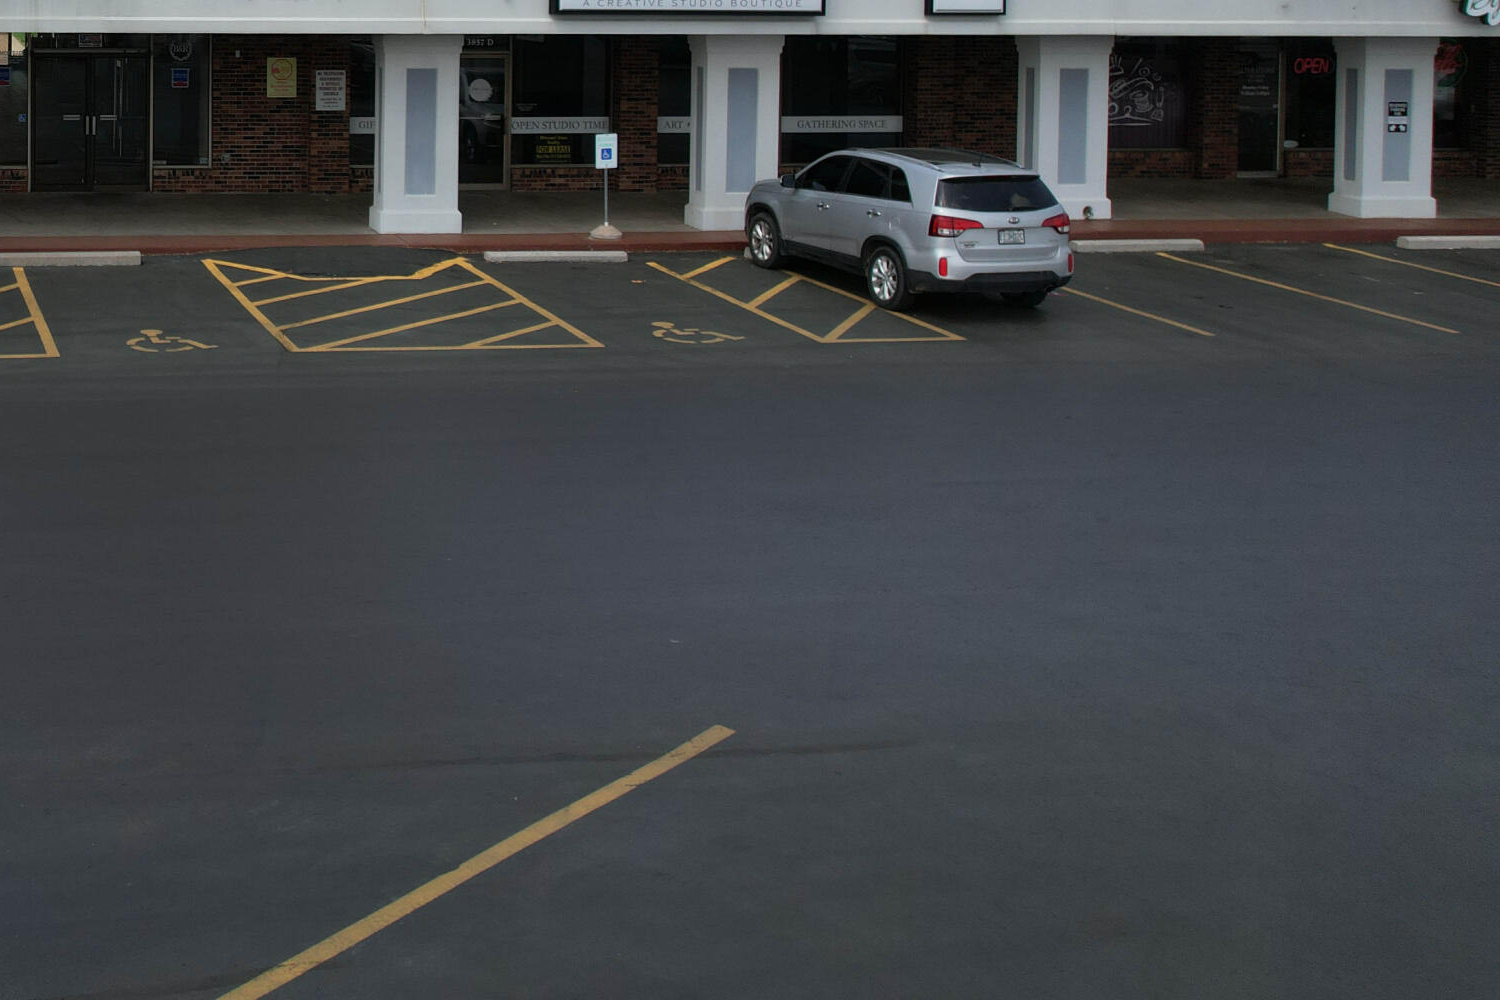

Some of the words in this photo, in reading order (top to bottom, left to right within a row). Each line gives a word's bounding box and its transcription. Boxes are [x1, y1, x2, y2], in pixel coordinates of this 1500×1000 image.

[582, 0, 590, 8] A
[597, 0, 664, 8] CREATIVE
[671, 0, 723, 8] STUDIO
[731, 0, 802, 9] BOUTIQUE
[487, 38, 494, 46] D
[1293, 57, 1330, 74] OPEN
[512, 120, 540, 129] OPEN
[541, 120, 580, 129] STUDIO
[582, 120, 607, 130] TIME
[663, 119, 684, 129] ART
[796, 119, 856, 129] GATHERING
[858, 119, 887, 129] SPACE
